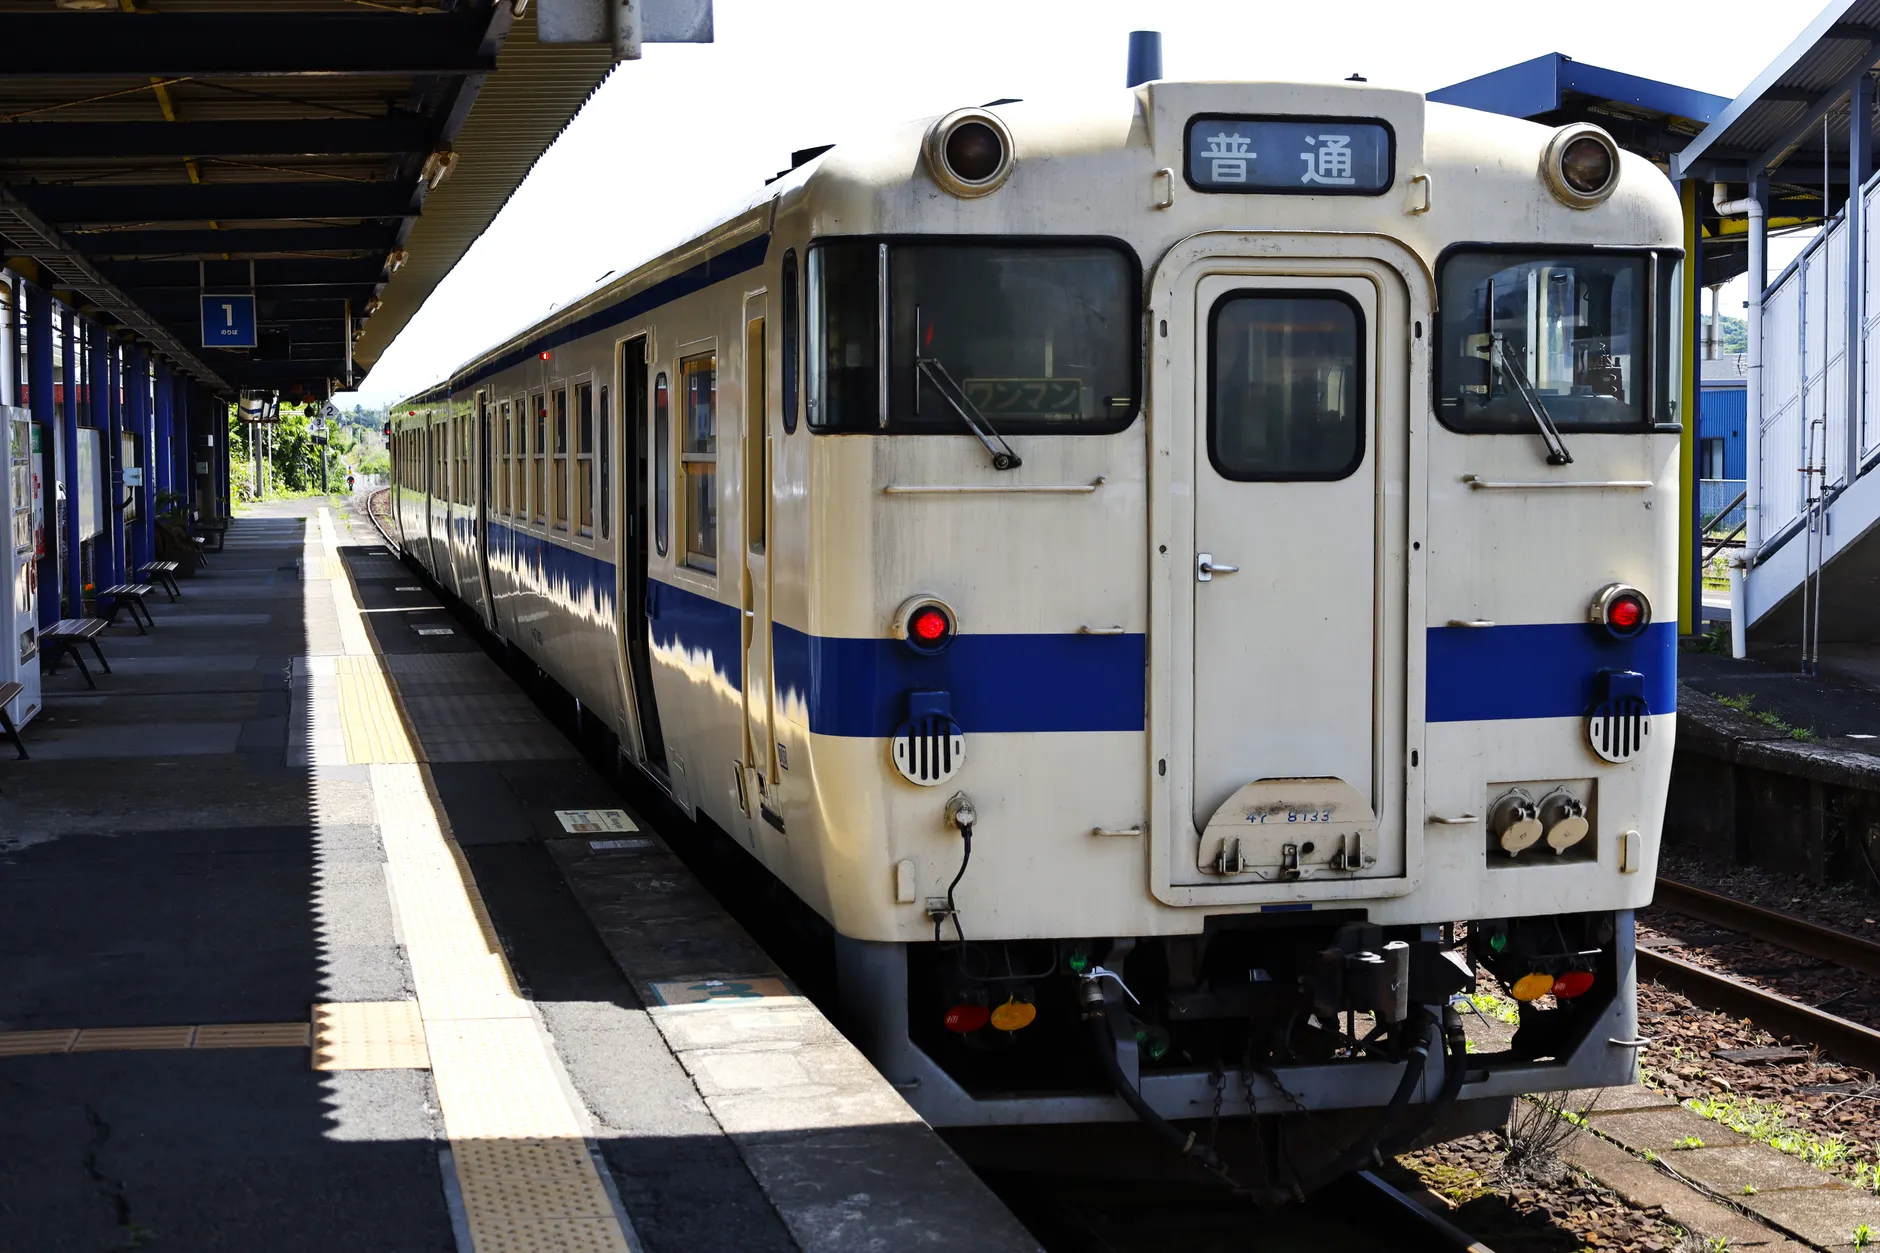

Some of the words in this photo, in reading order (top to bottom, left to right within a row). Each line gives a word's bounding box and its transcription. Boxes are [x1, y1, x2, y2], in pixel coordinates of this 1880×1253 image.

[1200, 132, 1356, 185] 普通
[221, 304, 233, 326] 1
[966, 383, 1079, 410] ワンマン
[326, 406, 334, 416] 2
[316, 418, 322, 426] 3
[1287, 809, 1330, 823] 8133
